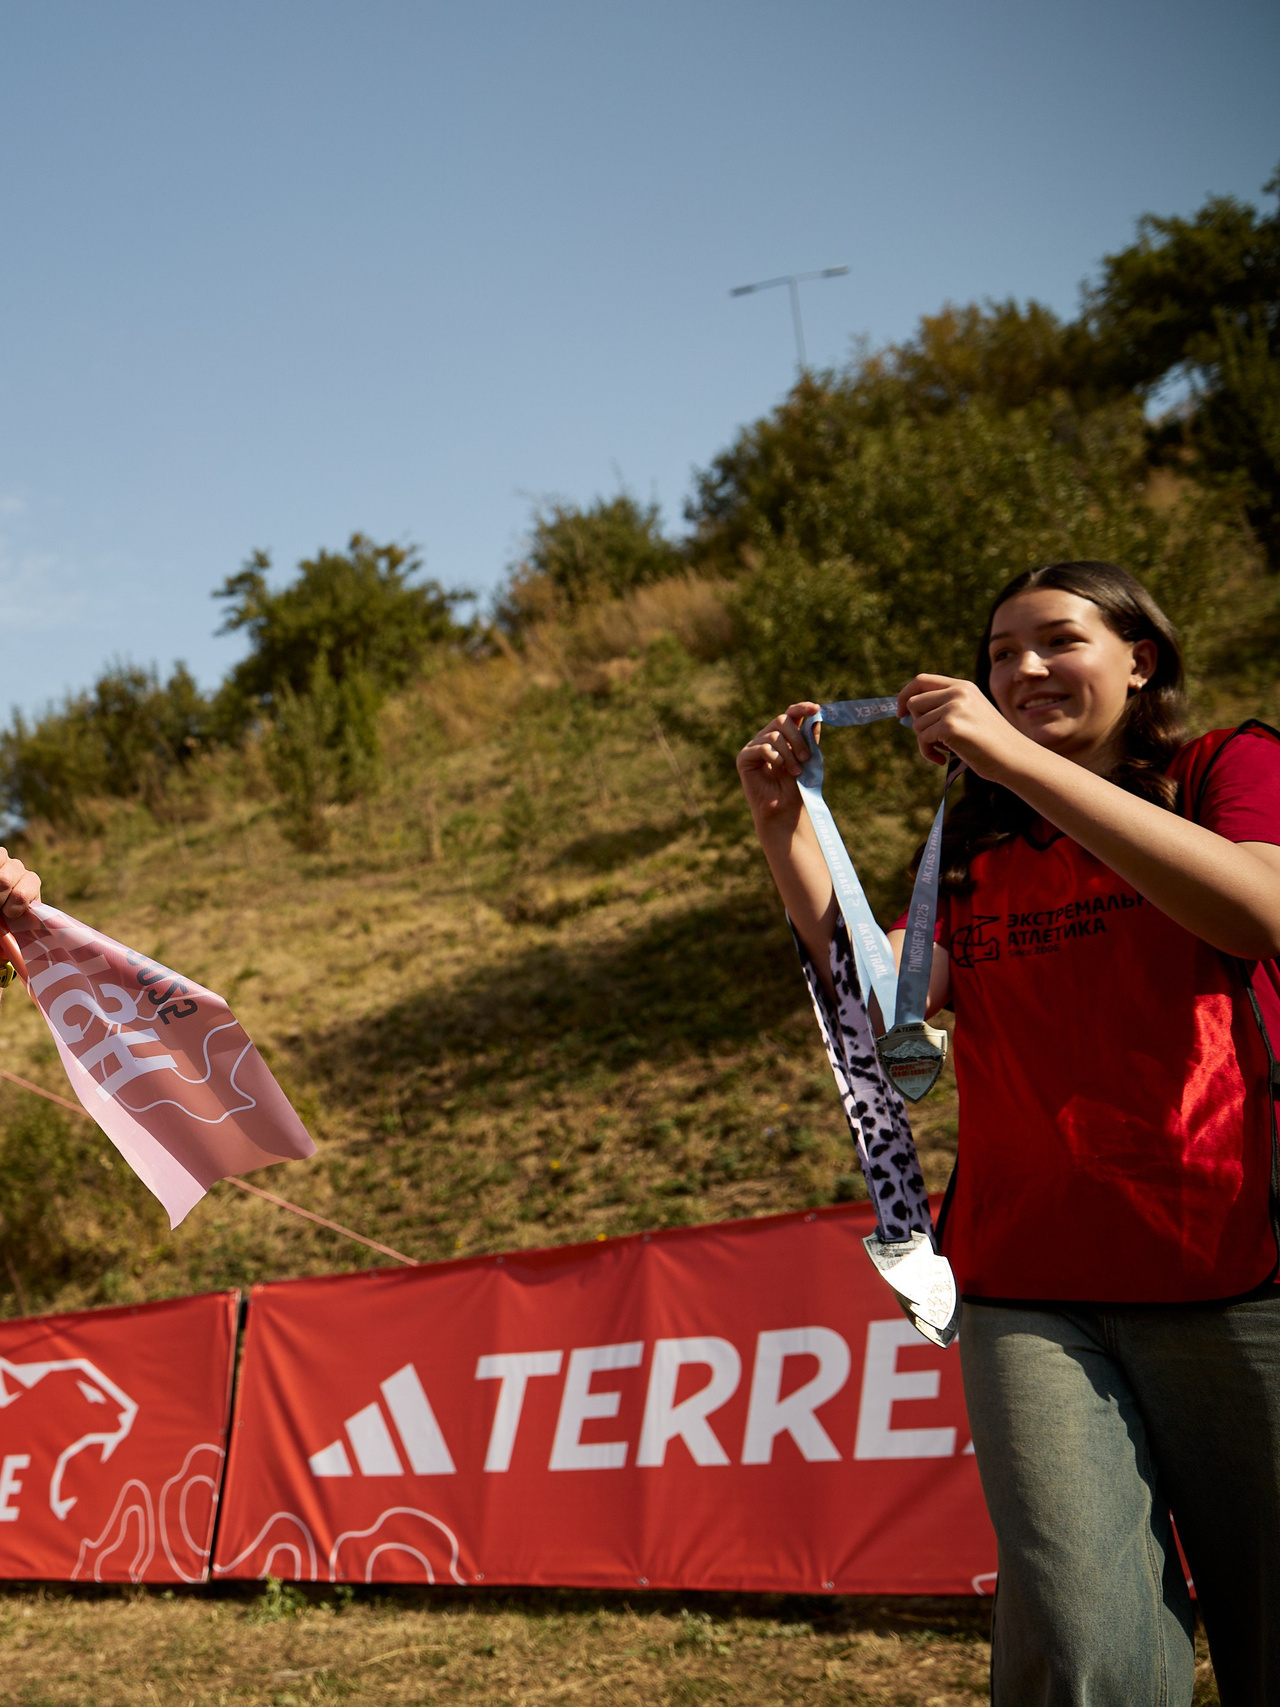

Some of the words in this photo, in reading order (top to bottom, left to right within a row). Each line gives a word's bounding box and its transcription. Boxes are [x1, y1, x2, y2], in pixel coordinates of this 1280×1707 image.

[921, 853, 936, 885] AKTAS
[929, 825, 941, 853] TRAIL
[857, 922, 877, 952] AKTAS
[870, 952, 888, 979] TRAIL
[907, 929, 926, 973] FINISHER
[918, 903, 930, 930] 2025
[1006, 917, 1107, 947] АТЛЕТИКА
[475, 1317, 977, 1474] TERRE
